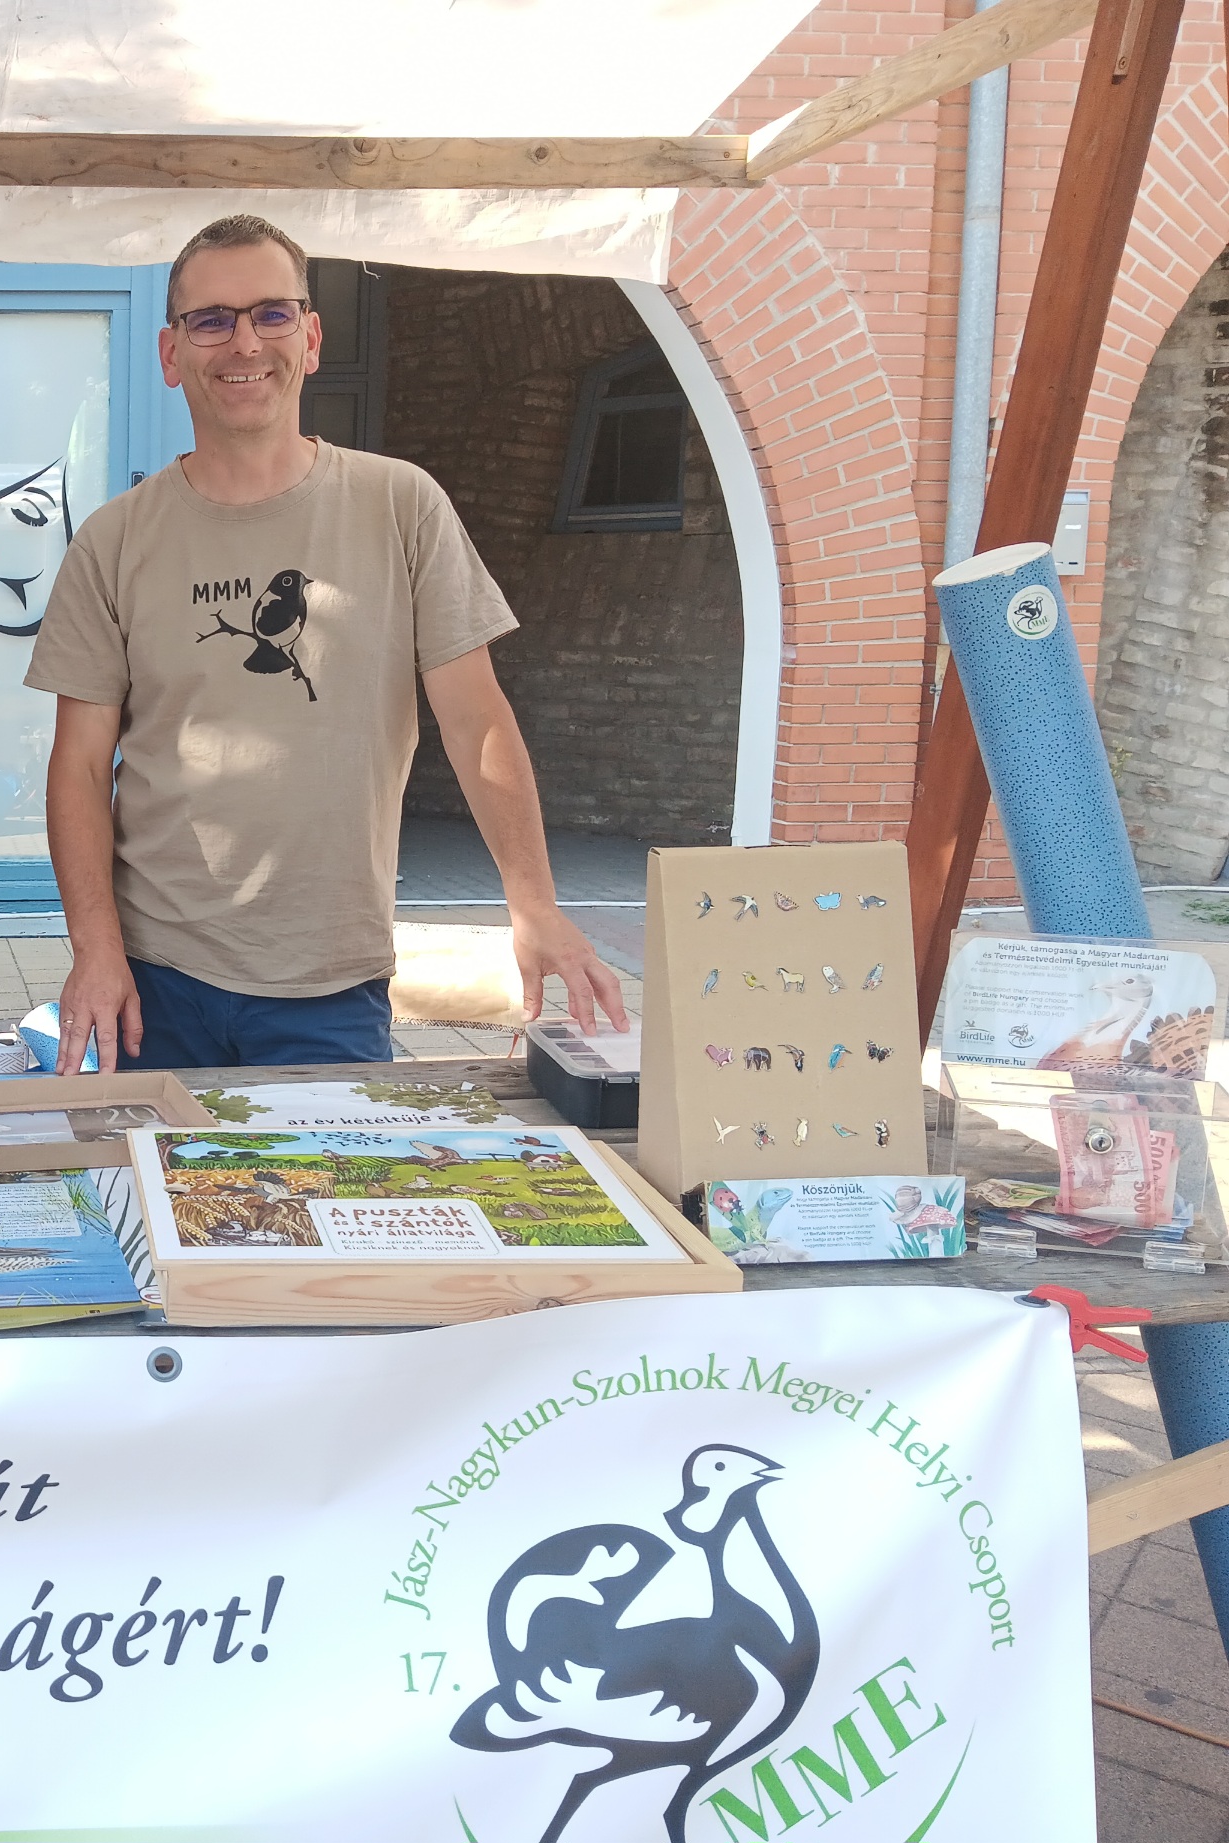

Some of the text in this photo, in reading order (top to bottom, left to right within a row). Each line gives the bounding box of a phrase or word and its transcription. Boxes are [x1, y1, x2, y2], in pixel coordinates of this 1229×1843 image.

[192, 561, 252, 604] MMM
[994, 952, 1073, 964] Természetvédelmi
[1077, 958, 1118, 967] Egyesület
[998, 943, 1027, 952] Kérjük,
[1031, 945, 1077, 955] támogassa
[1088, 950, 1121, 958] Magyar
[1123, 951, 1169, 961] Madártani
[1000, 994, 1029, 1002] Hungary
[960, 1031, 995, 1041] BirdLife
[957, 1055, 1026, 1066] www.mme.hu
[94, 1105, 160, 1125] 20
[802, 1184, 865, 1196] Köszönjük,
[1133, 1180, 1152, 1214] 500
[329, 1205, 466, 1221] A puszták
[371, 1217, 472, 1228] szántók
[337, 1228, 476, 1238] nyári állatvilága
[384, 1352, 1017, 1697] 17. Jász-Nagykun-Szolnok Megyei Helyi Csoport
[699, 1656, 947, 1843] MME
